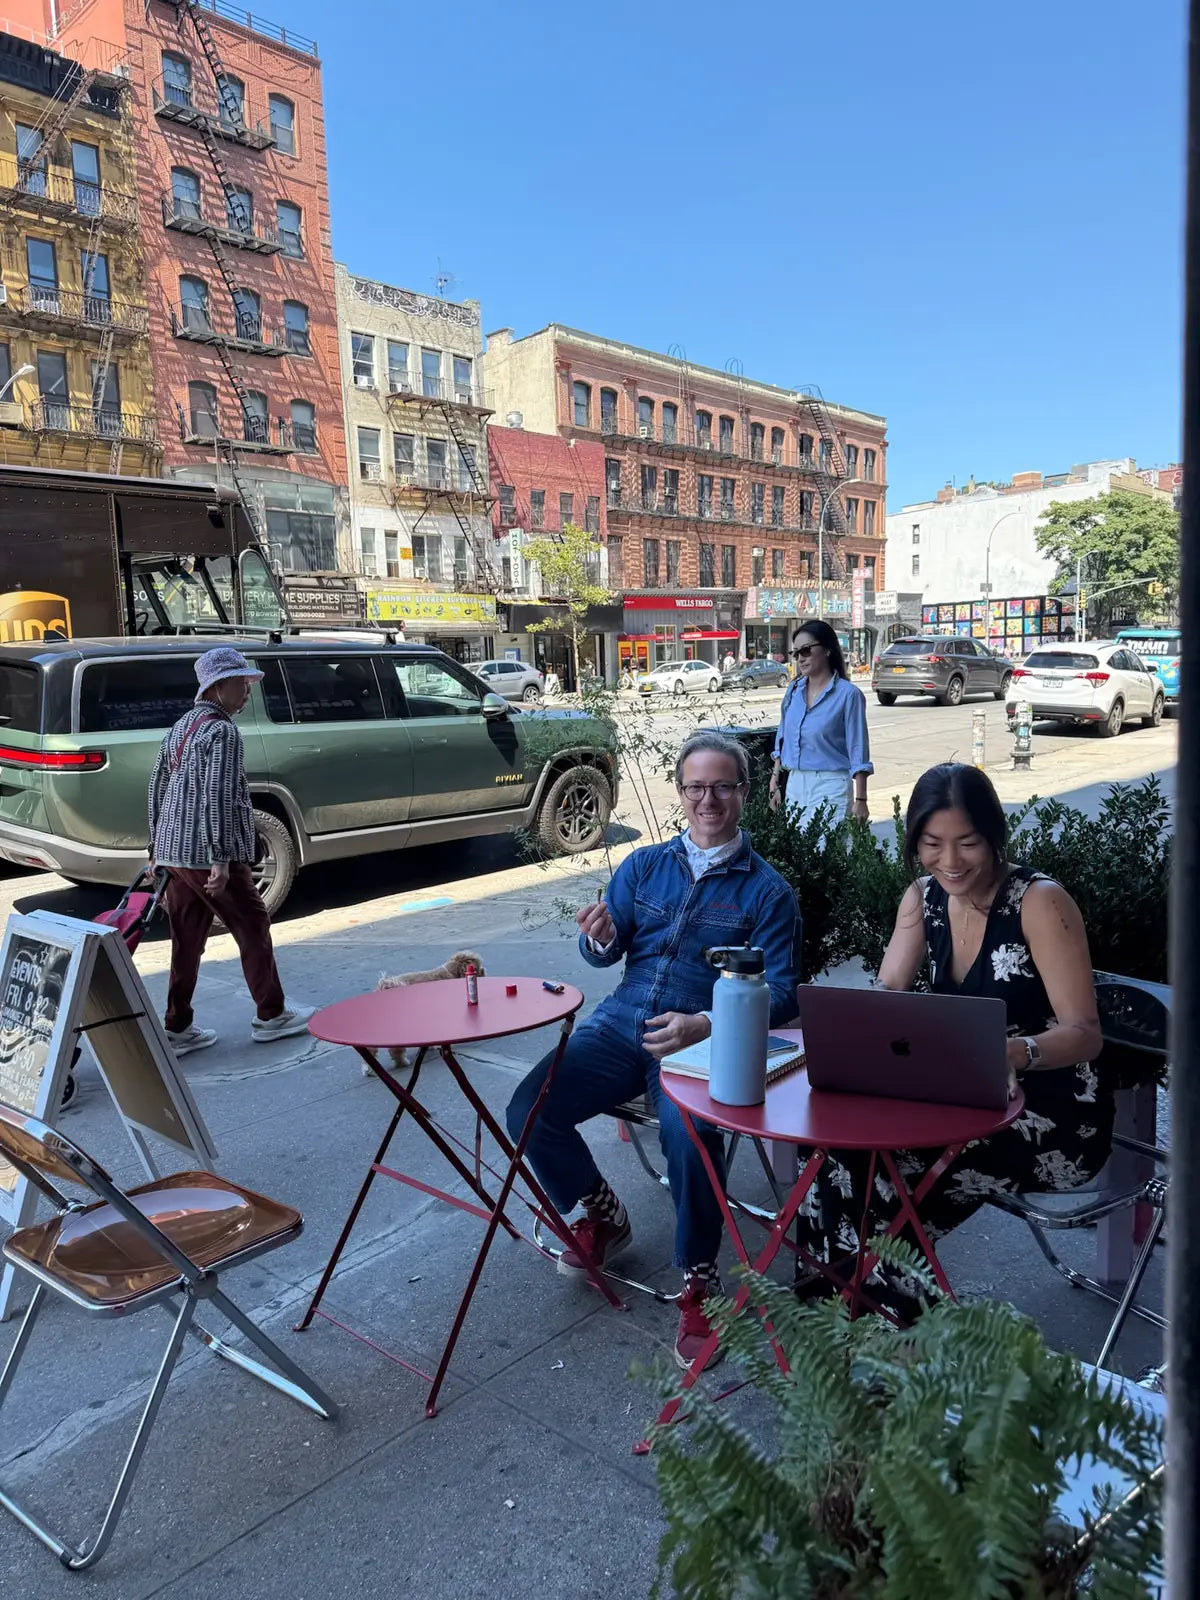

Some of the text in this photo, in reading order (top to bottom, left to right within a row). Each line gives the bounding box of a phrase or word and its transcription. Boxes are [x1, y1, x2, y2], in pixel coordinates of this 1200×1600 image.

[296, 592, 340, 604] SUPPLIES
[675, 599, 713, 607] WELLS FARGO
[495, 773, 523, 783] RIVIAN
[10, 959, 42, 987] EVENTS
[6, 984, 24, 1007] FRI
